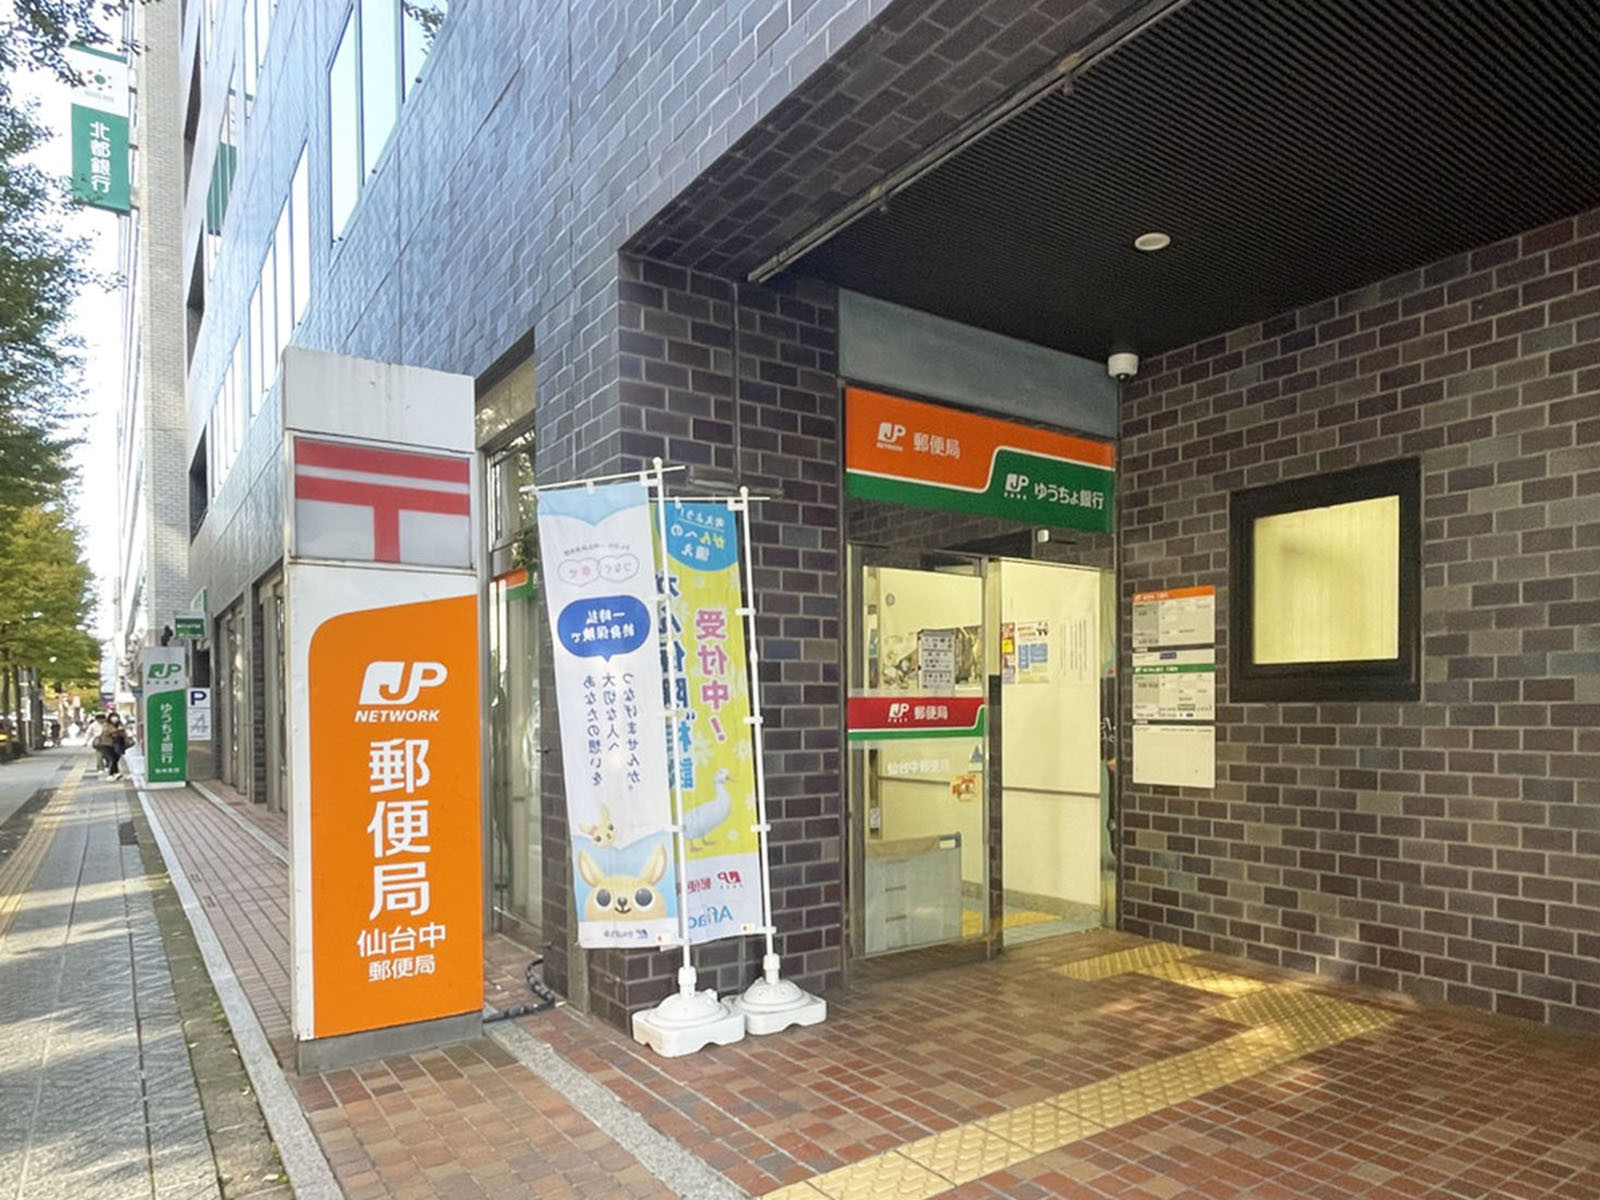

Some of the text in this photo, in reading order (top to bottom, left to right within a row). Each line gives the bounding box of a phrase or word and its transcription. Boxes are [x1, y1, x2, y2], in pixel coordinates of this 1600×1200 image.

[913, 432, 961, 460] 郵便局
[1034, 482, 1104, 510] ゆうちょ銀行
[359, 661, 448, 705] JP
[191, 690, 207, 706] P
[354, 709, 440, 723] NETWORK
[914, 705, 948, 720] 郵便局
[367, 738, 431, 921] 郵便局
[357, 922, 447, 957] 仙台中
[368, 954, 436, 982] 郵便局
